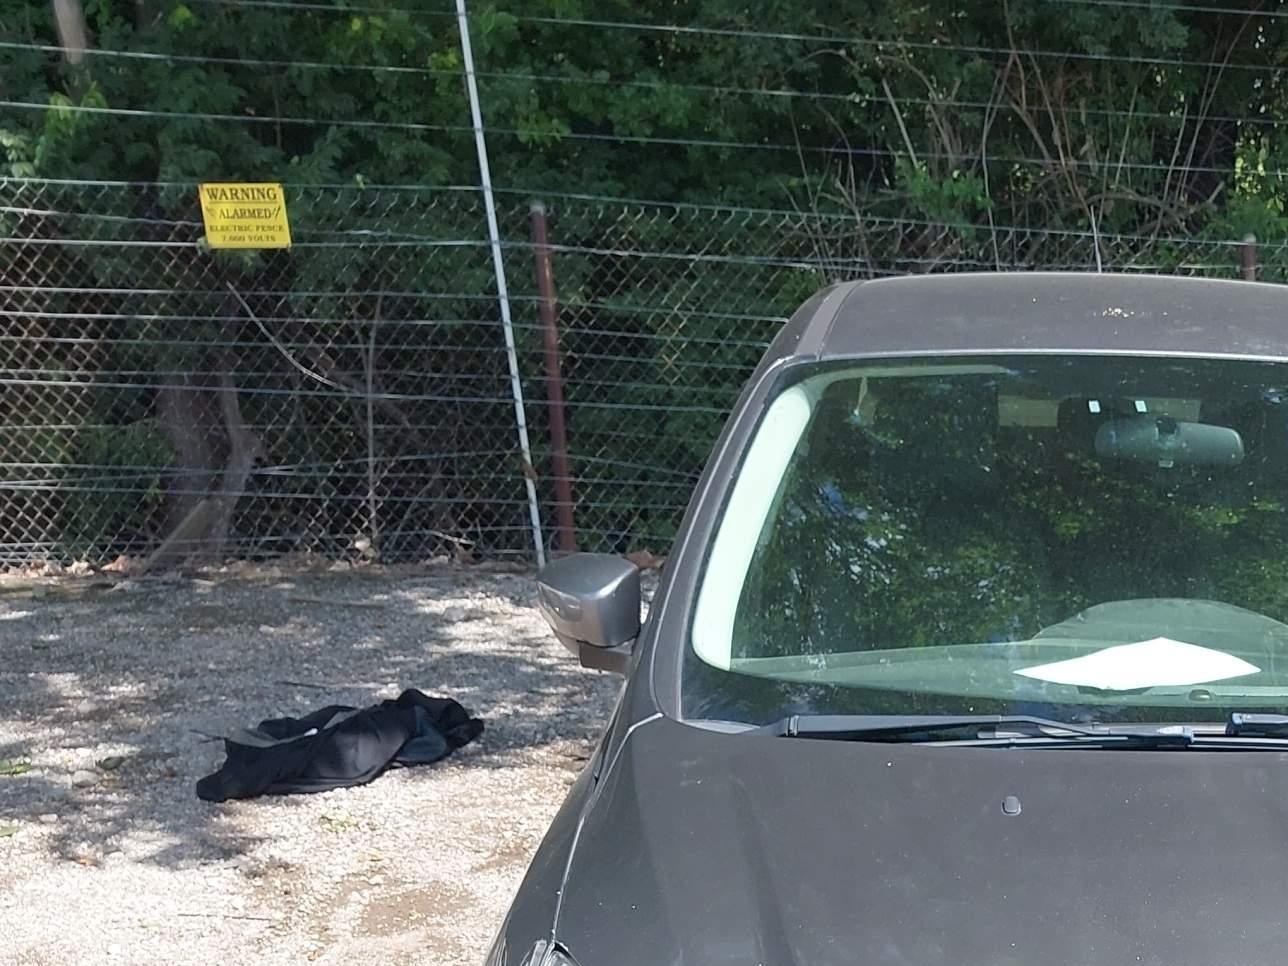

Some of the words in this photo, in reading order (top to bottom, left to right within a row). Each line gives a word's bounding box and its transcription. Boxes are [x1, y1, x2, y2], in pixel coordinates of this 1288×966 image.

[206, 187, 277, 200] WARNING
[219, 207, 271, 219] ALARMED
[209, 224, 253, 232] ELECTRIC
[255, 224, 284, 232] FENCE
